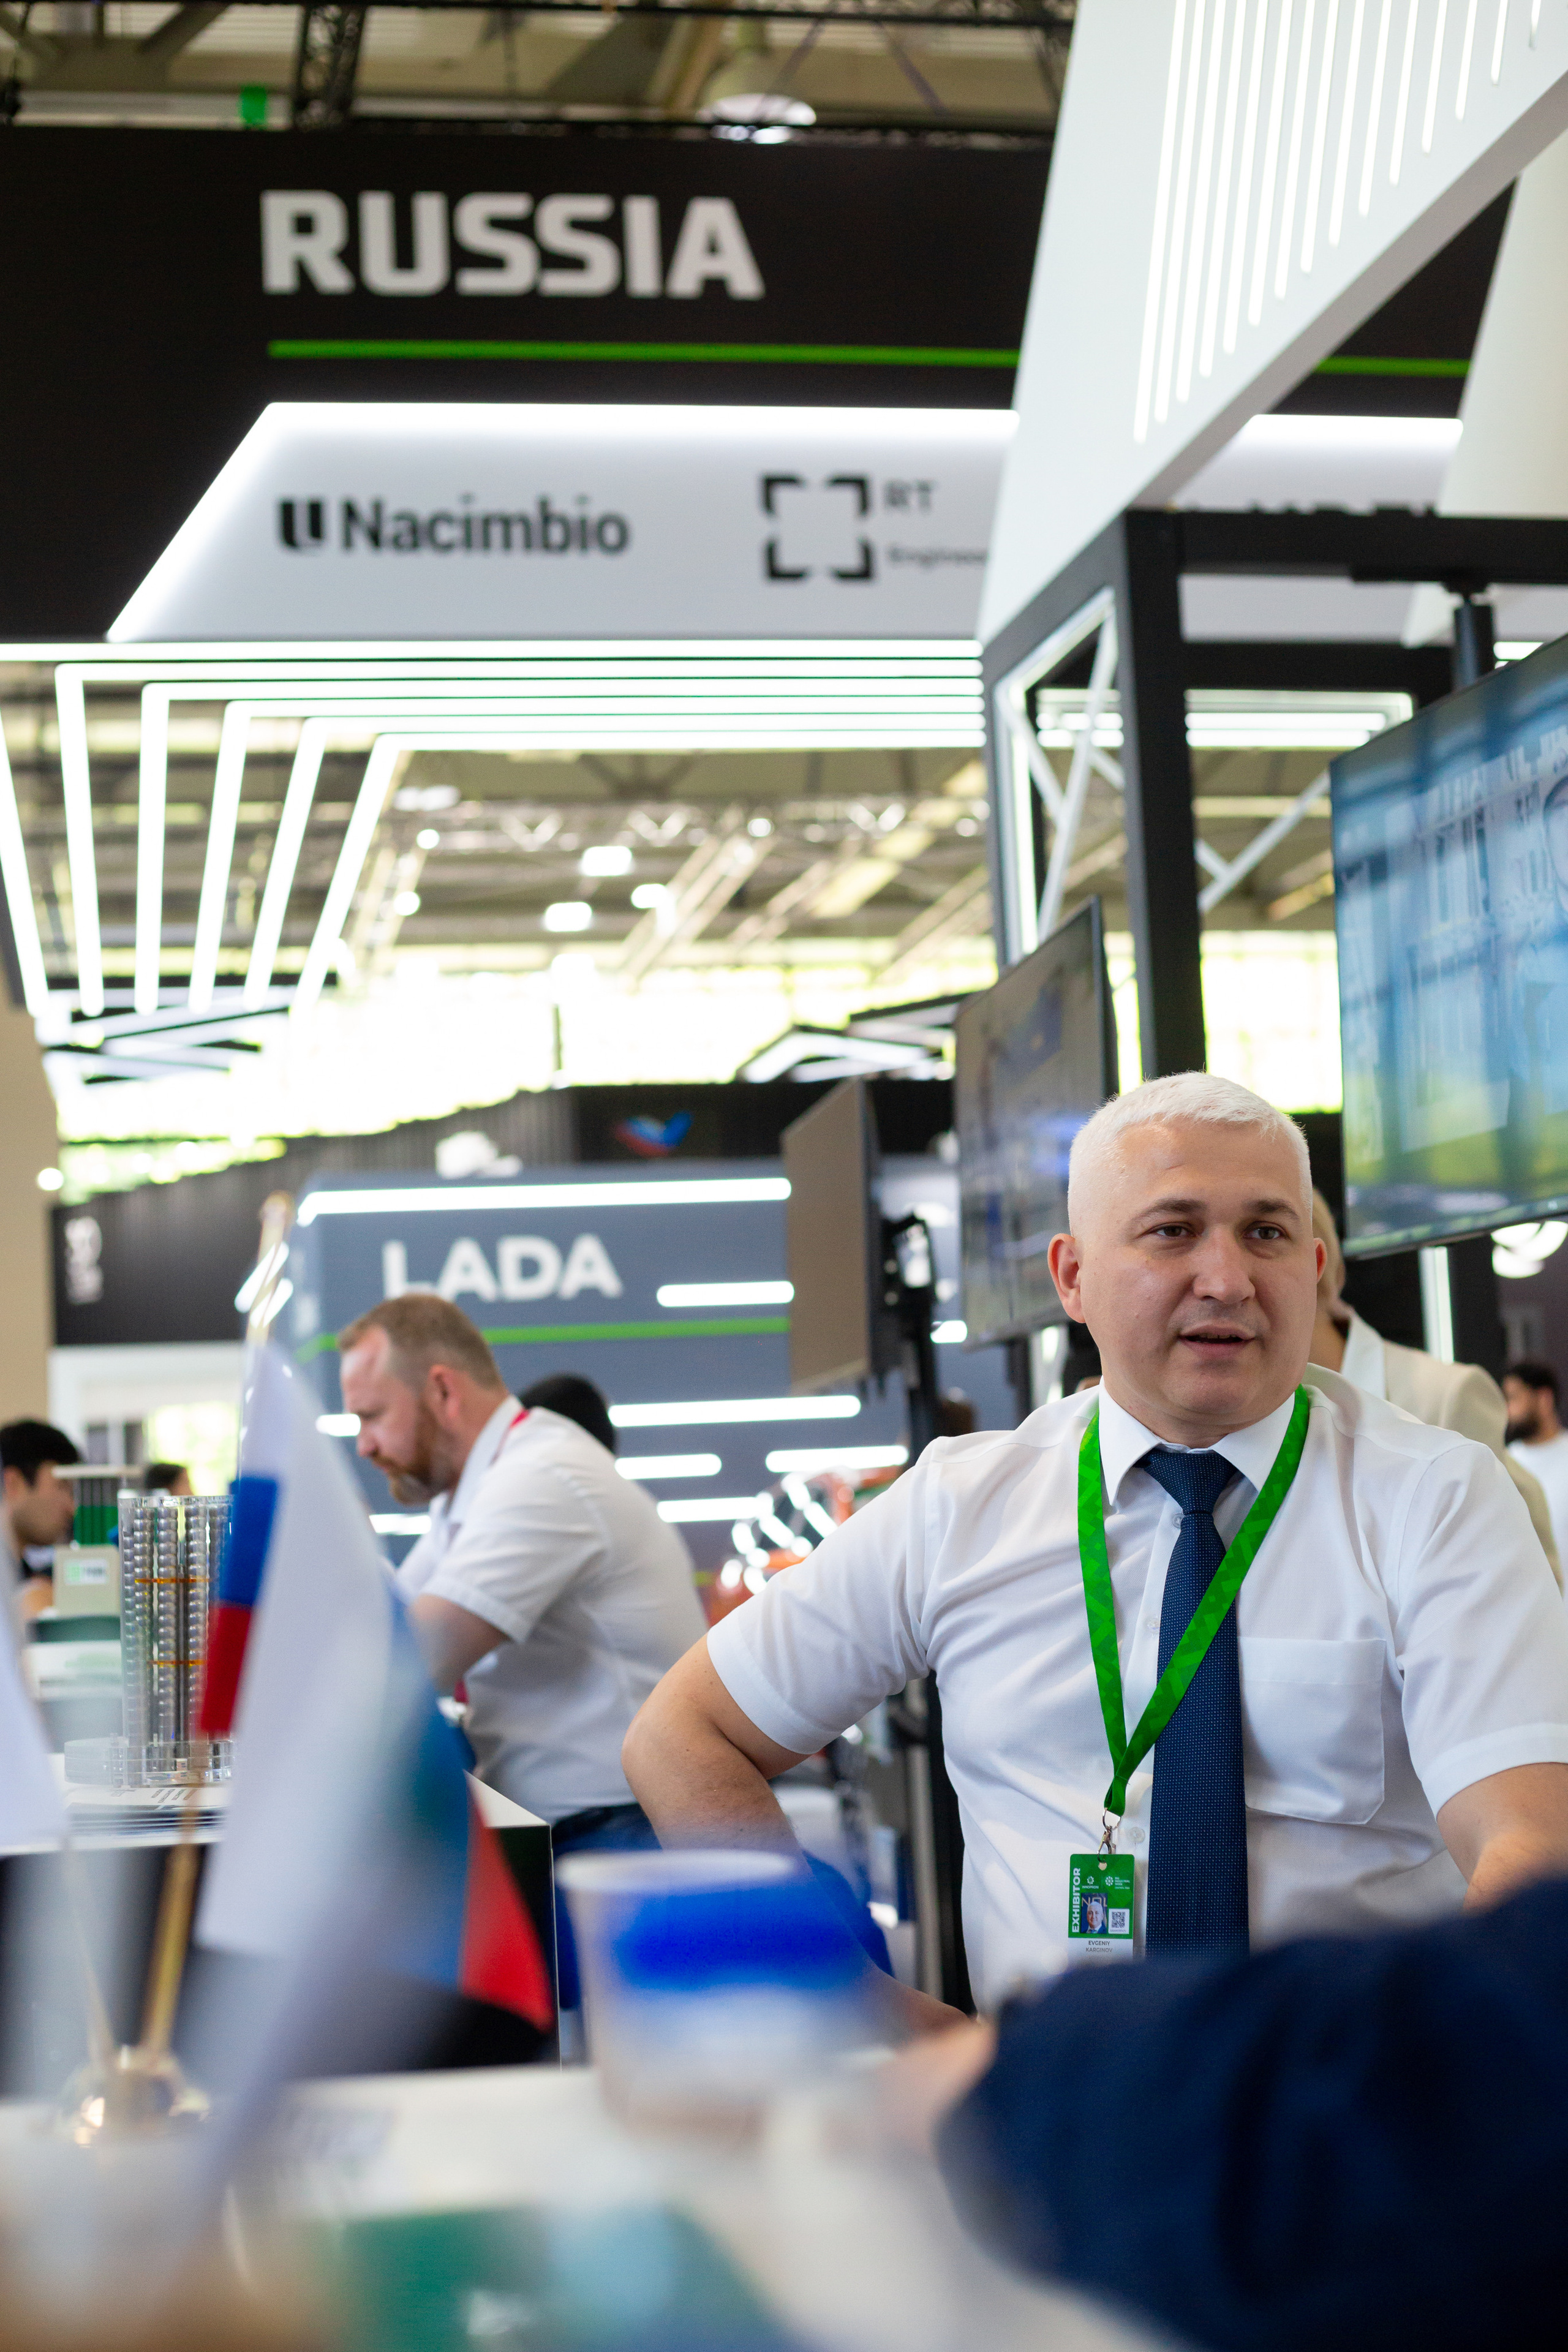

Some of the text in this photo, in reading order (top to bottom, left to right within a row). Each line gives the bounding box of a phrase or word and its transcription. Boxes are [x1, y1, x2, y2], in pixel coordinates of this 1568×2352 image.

[261, 190, 765, 300] RUSSIA
[340, 492, 631, 555] Nacimbio
[382, 1233, 622, 1302] LADA
[1072, 1868, 1080, 1932] EXHIBITOR
